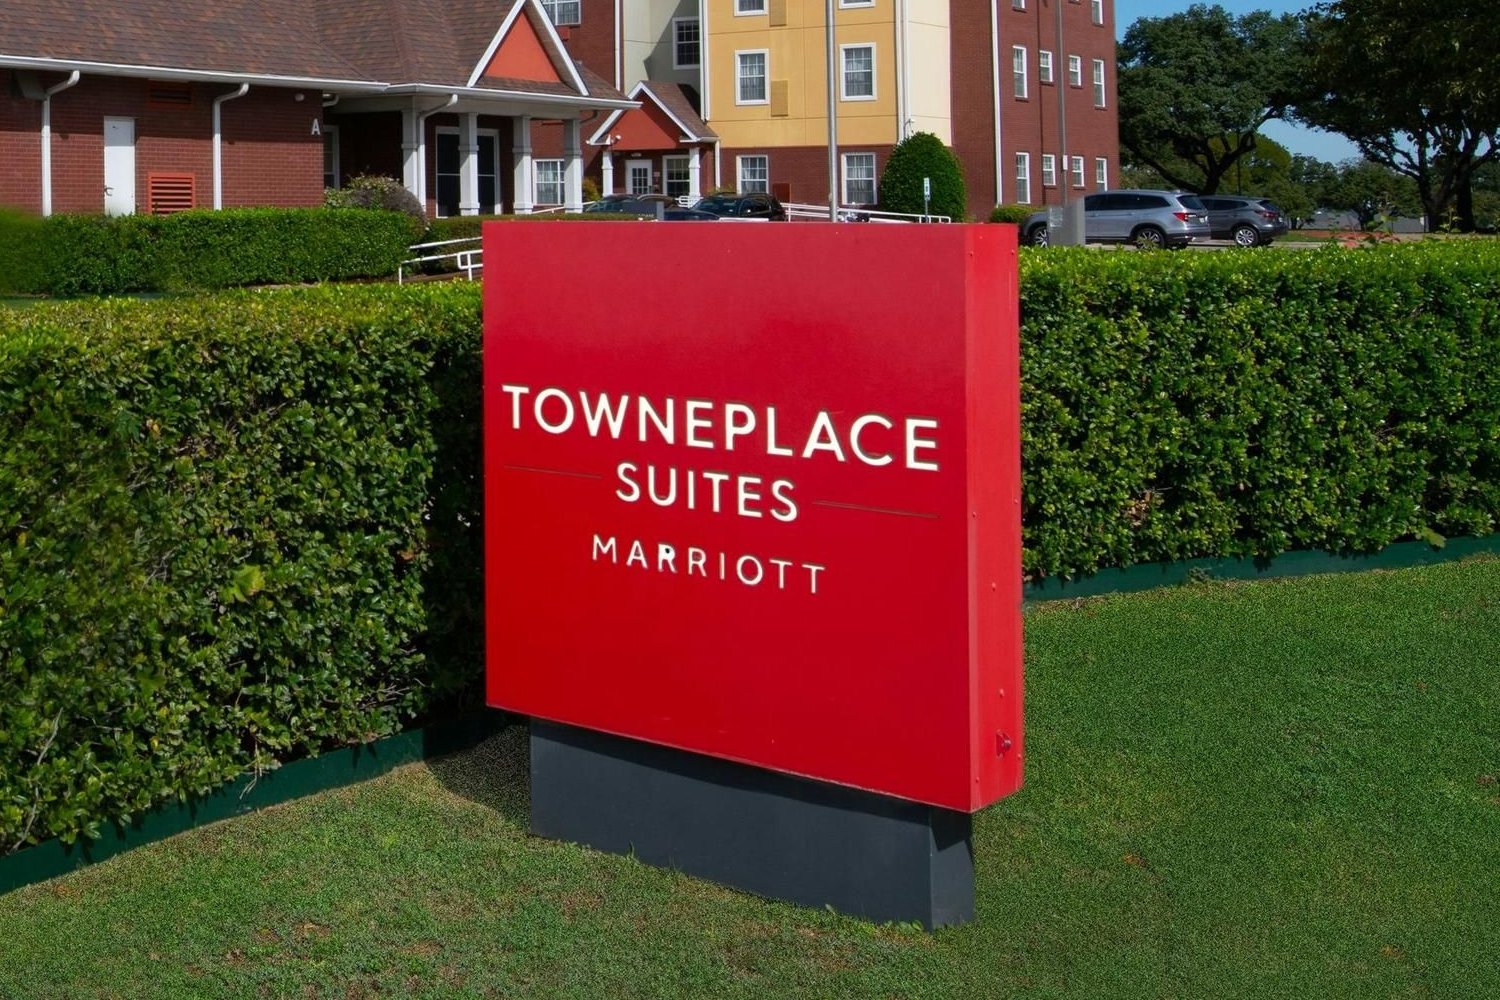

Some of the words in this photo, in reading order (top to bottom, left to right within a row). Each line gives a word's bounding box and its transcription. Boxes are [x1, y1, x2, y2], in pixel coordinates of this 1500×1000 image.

[311, 118, 321, 136] A
[502, 384, 940, 473] TOWNEPLACE
[616, 462, 799, 523] SUITES
[592, 534, 826, 595] MARRIOTT
